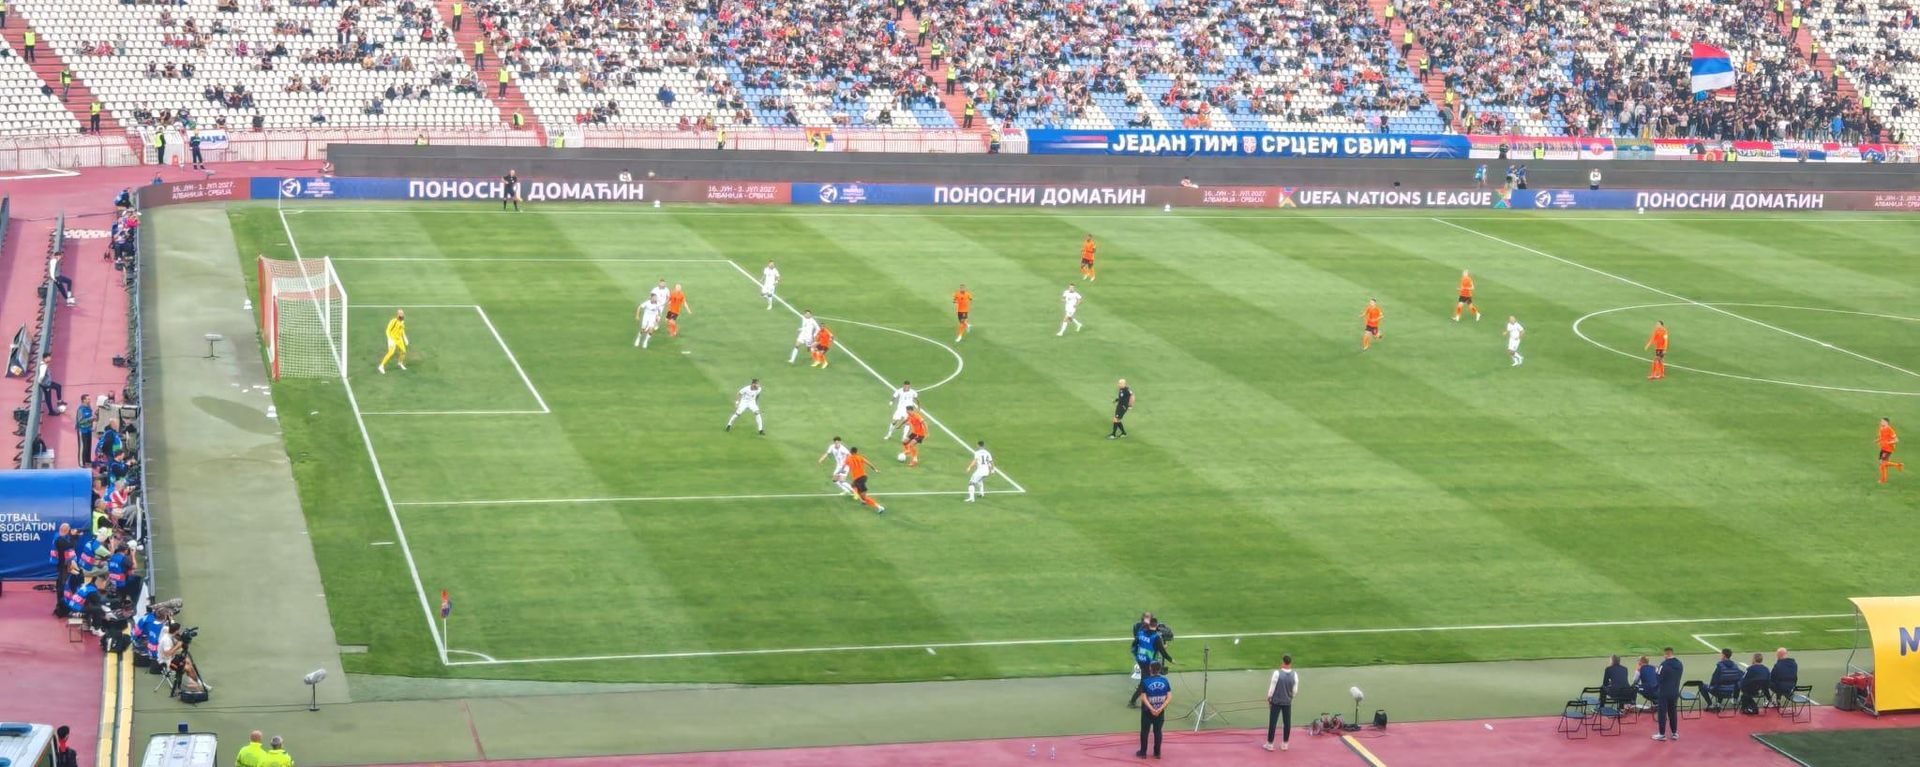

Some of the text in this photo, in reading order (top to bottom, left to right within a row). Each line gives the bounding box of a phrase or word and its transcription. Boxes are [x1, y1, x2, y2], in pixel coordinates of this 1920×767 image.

[1112, 134, 1407, 155] ЈЕДАН ТИМ СРЦЕМ СВИМ
[528, 182, 644, 201] ДОМАЋИН
[934, 186, 1146, 205] ПОНОСНИ ДОМАЋИН
[1300, 190, 1491, 206] UEFA NATIONS LEAGUE
[1636, 192, 1824, 210] ПОНОСНИ ДОМАЋИН
[0, 512, 40, 522] OTBALL
[0, 522, 56, 532] SOCIATION
[1, 532, 40, 542] SERBIA
